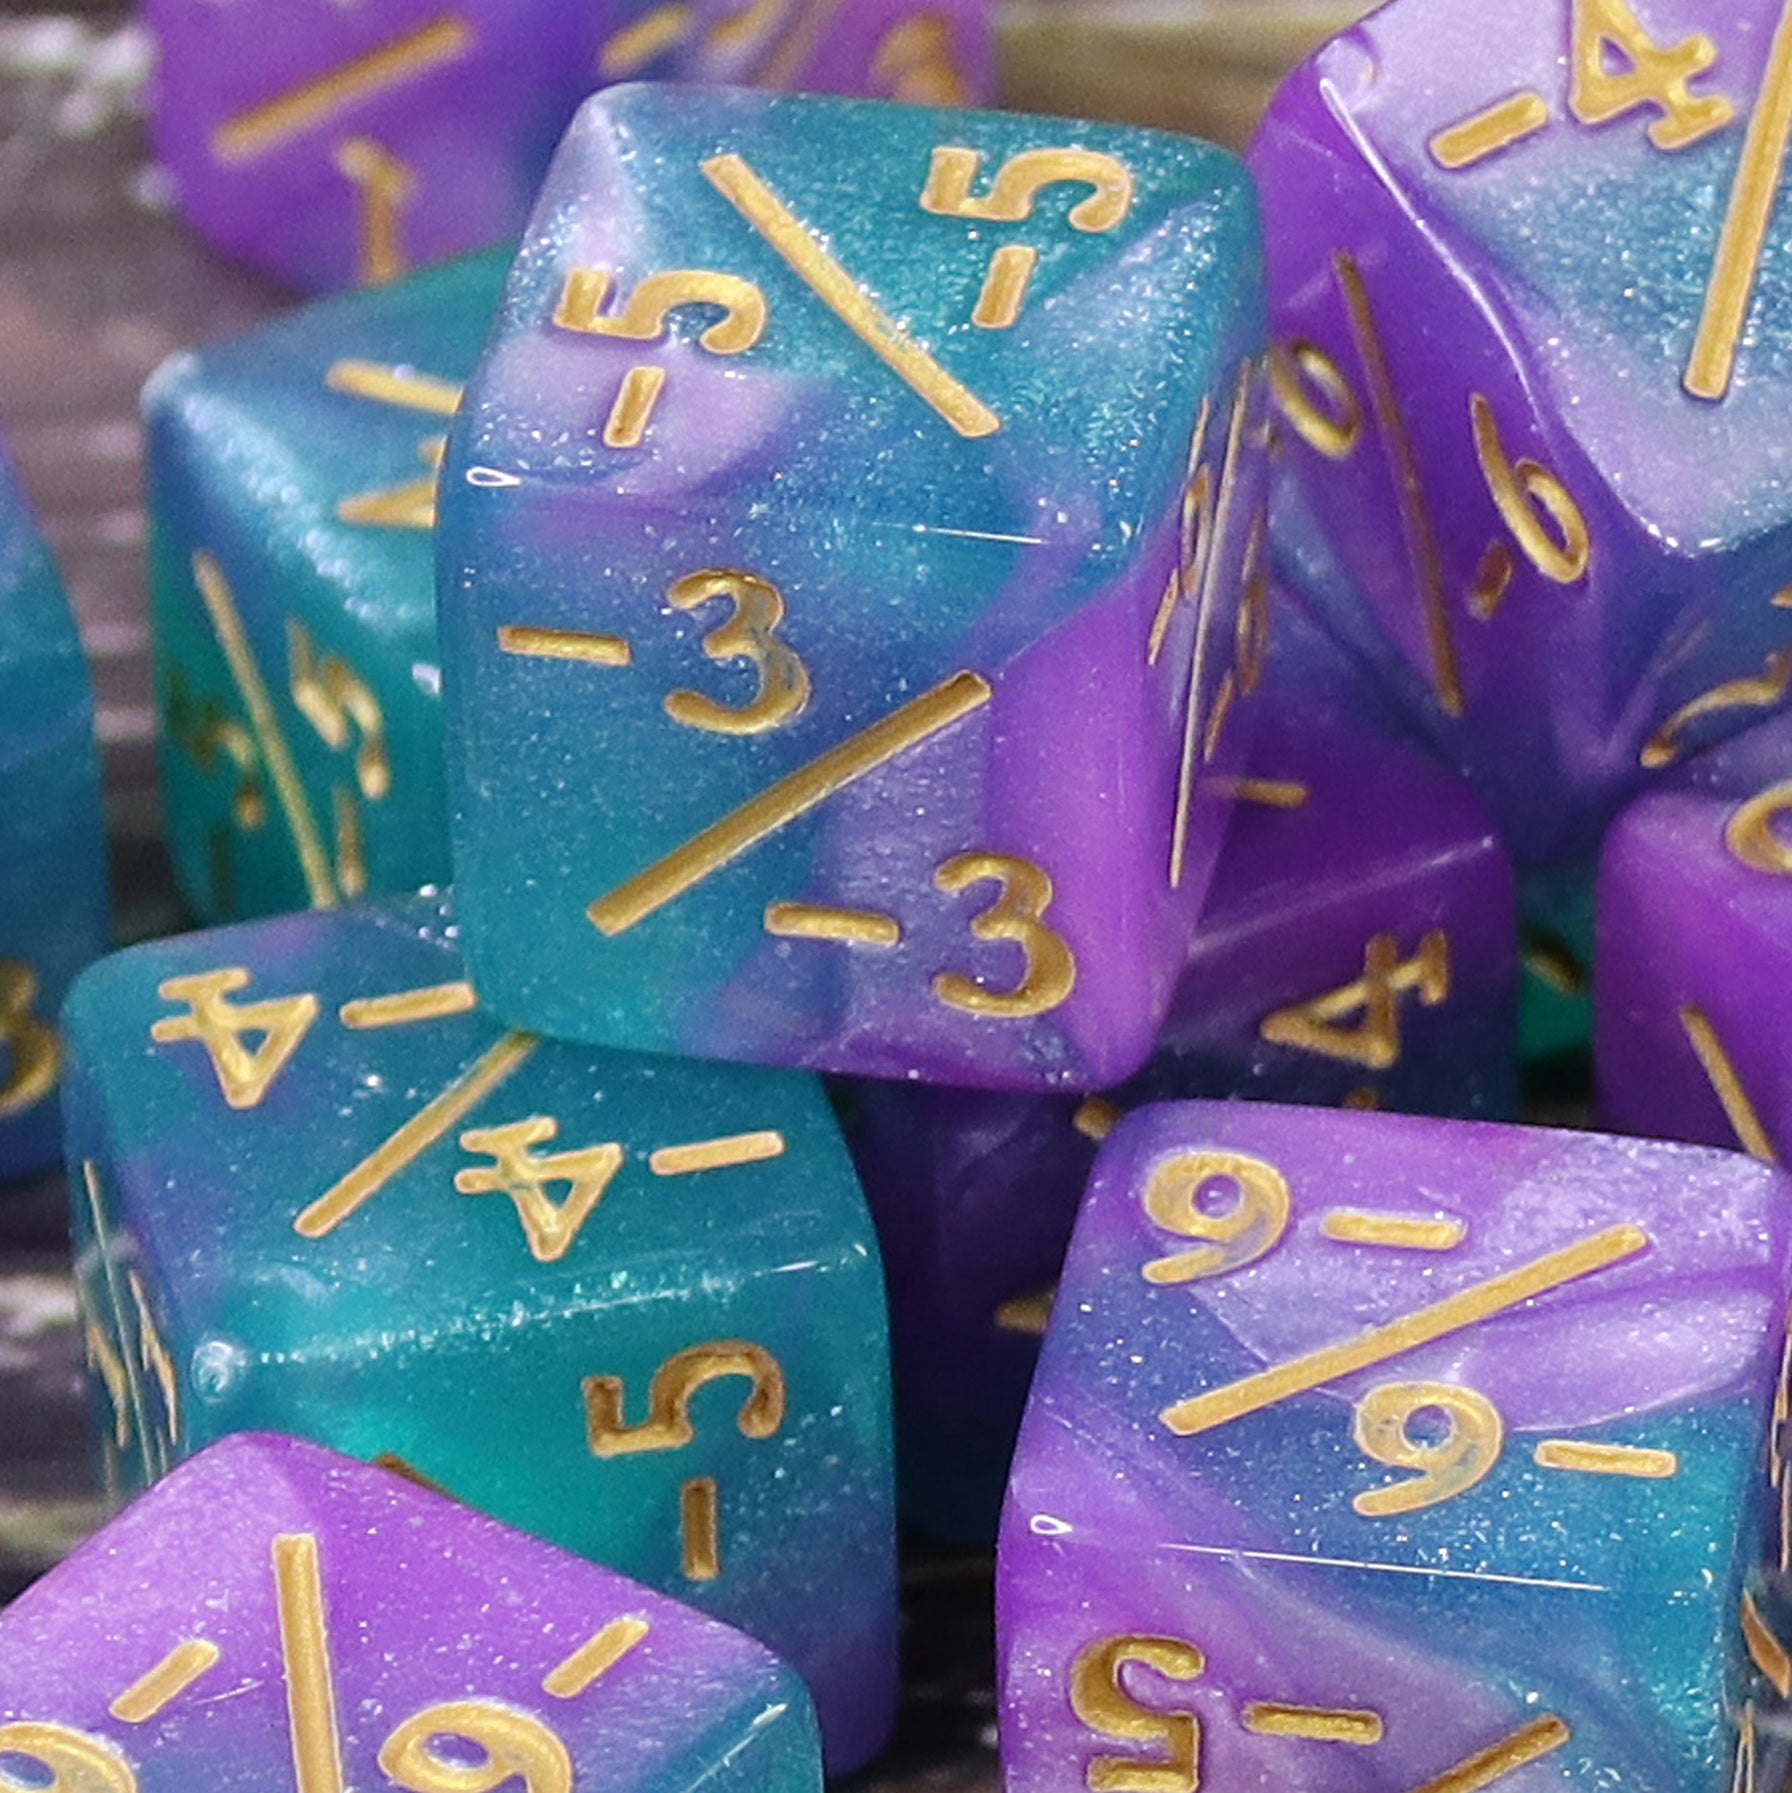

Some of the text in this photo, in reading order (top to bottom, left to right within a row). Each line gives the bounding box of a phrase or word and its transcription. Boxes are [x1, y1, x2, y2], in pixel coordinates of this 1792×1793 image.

[497, 567, 811, 735] -3
[763, 850, 1076, 1017] -3
[1260, 930, 1449, 1110] 4
